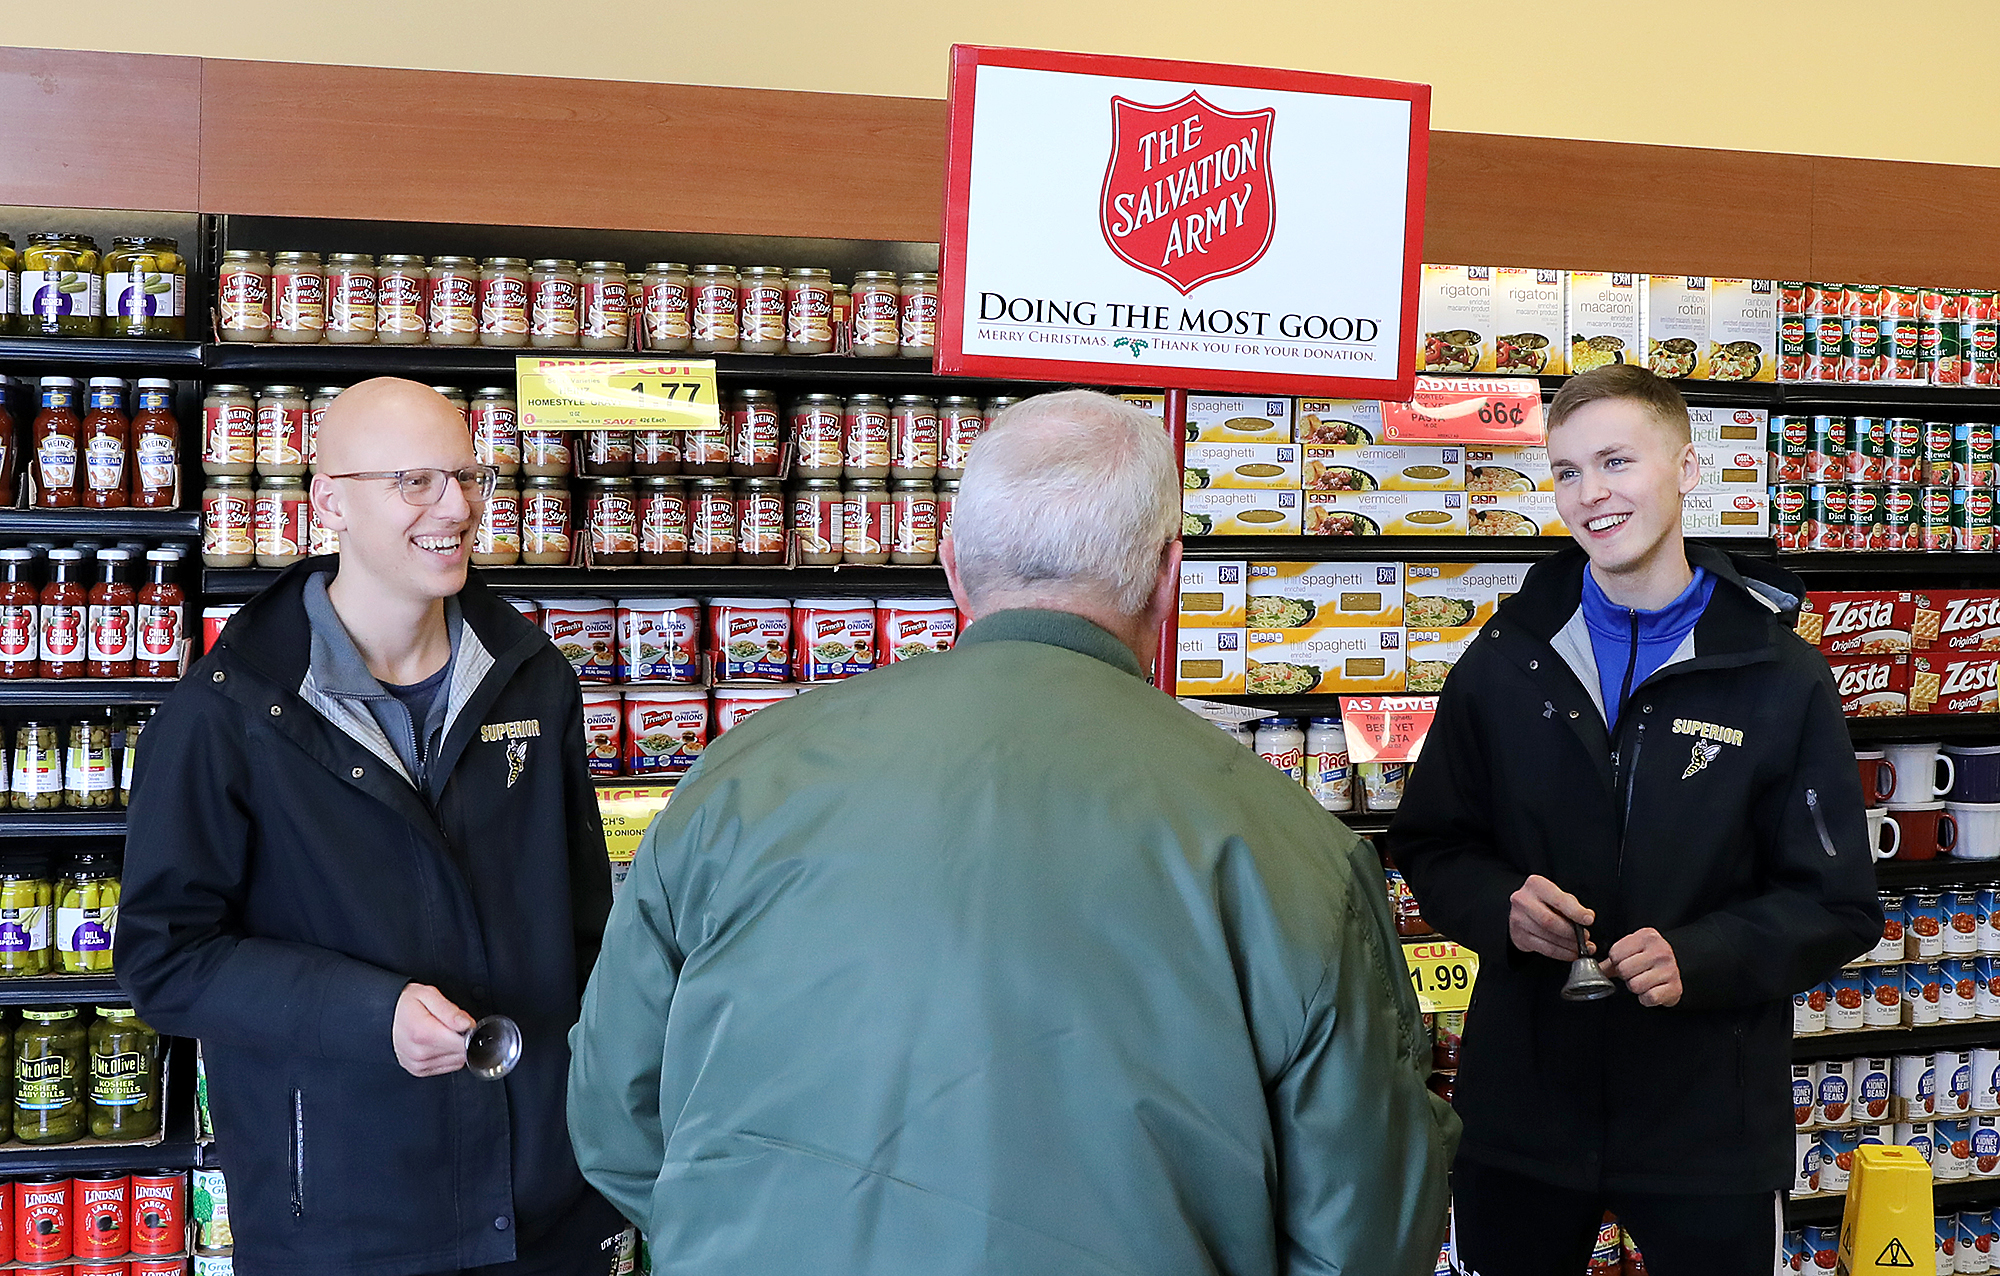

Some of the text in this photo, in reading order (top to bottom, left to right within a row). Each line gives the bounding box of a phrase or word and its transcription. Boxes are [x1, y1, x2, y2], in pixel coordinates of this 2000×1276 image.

[1137, 114, 1204, 172] THE
[1111, 127, 1259, 238] SALVATION
[1161, 182, 1253, 267] ARMY
[231, 276, 258, 288] HEINZ
[442, 280, 468, 291] HEINZ
[495, 281, 520, 292] HEINZ
[656, 287, 682, 298] HEINZ
[703, 287, 731, 299] HEINZ
[1440, 284, 1490, 299] rigatoni
[1509, 289, 1558, 303] rigatoni
[1599, 290, 1633, 301] elbow
[41, 298, 63, 307] KOSHER
[867, 294, 892, 306] HEINZ
[978, 291, 1098, 326] DOING
[1106, 303, 1170, 331] THE
[1178, 307, 1271, 336] MOST
[1580, 302, 1634, 314] macaroni
[1677, 304, 1706, 316] rotini
[1741, 306, 1771, 319] rotini
[977, 328, 1110, 347] MERRY CHRISTMAS.
[1151, 337, 1377, 362] THANK YOU FOR YOUR DONATION.
[1820, 344, 1841, 353] Diced
[1853, 346, 1875, 355] Diced
[1415, 380, 1533, 393] ADVERTISED
[1191, 401, 1244, 413] spaghetti
[1478, 401, 1524, 428] 66¢
[602, 418, 638, 426] SAVE
[810, 415, 835, 426] HEINZ
[47, 440, 71, 449] HEINZ
[93, 441, 117, 450] HEINZ
[145, 439, 168, 448] HEINZ
[1201, 447, 1255, 460] spaghetti
[1356, 448, 1406, 460] vermicelli
[1893, 446, 1916, 455] Diced
[1924, 451, 1950, 459] Stewed
[1968, 451, 1993, 460] Stewed
[42, 456, 74, 464] COCKTAIL
[89, 457, 121, 465] COCKTAIL
[140, 455, 172, 464] COCKTAIL
[1514, 450, 1549, 463] linguin
[1204, 493, 1257, 506] spaghetti
[1358, 493, 1408, 505] vermicelli
[215, 502, 242, 513] HEINZ
[601, 500, 626, 511] HEINZ
[651, 501, 679, 512] HEINZ
[1777, 512, 1801, 521] Diced
[1922, 515, 1949, 524] Stewed
[1301, 573, 1363, 588] spaghetti
[1461, 573, 1519, 588] spaghetti
[1823, 599, 1894, 637] Zesta
[584, 624, 613, 632] ONIONS
[759, 622, 787, 630] ONIONS
[847, 623, 874, 631] ONIONS
[929, 622, 955, 631] ONIONS
[2, 628, 22, 637] CHILI
[52, 628, 71, 637] CHILI
[101, 628, 121, 637] CHILI
[149, 628, 168, 637] CHILI
[0, 637, 25, 646] SAUCE
[49, 637, 74, 646] SAUCE
[98, 637, 123, 646] SAUCE
[146, 637, 170, 646] SAUCE
[1308, 638, 1367, 653] spaghetti
[1831, 637, 1862, 652] Original
[1949, 633, 1981, 649] Original
[1939, 659, 1998, 696] Zest
[1347, 699, 1373, 711] AS
[1948, 696, 1979, 711] Original
[587, 715, 616, 724] ONIONS
[674, 713, 703, 722] ONIONS
[480, 719, 541, 742] SUPERIOR
[1395, 723, 1414, 731] YET
[1671, 718, 1744, 747] SUPERIOR
[1375, 734, 1410, 743] PSTA
[3, 932, 17, 940] DILL
[84, 931, 99, 939] DILL
[1413, 944, 1460, 959] CUT
[1410, 964, 1469, 992] 1.99
[34, 1061, 59, 1077] Olive
[110, 1059, 136, 1074] Olive
[99, 1080, 134, 1088] KOSHER
[1822, 1084, 1846, 1093] KIDNEY
[1866, 1081, 1887, 1091] KIDNEY
[18, 1090, 65, 1098] BABY DILLS
[94, 1086, 141, 1094] BABY DILLS
[1867, 1089, 1886, 1098] BEANS
[1823, 1092, 1844, 1101] BEANS
[84, 1188, 124, 1206] LINDSAY
[135, 1185, 174, 1202] LINDSAY
[24, 1191, 65, 1209] LINDSAY
[139, 1200, 166, 1211] LARGE
[31, 1206, 58, 1218] LARGE
[91, 1203, 118, 1214] LARGE
